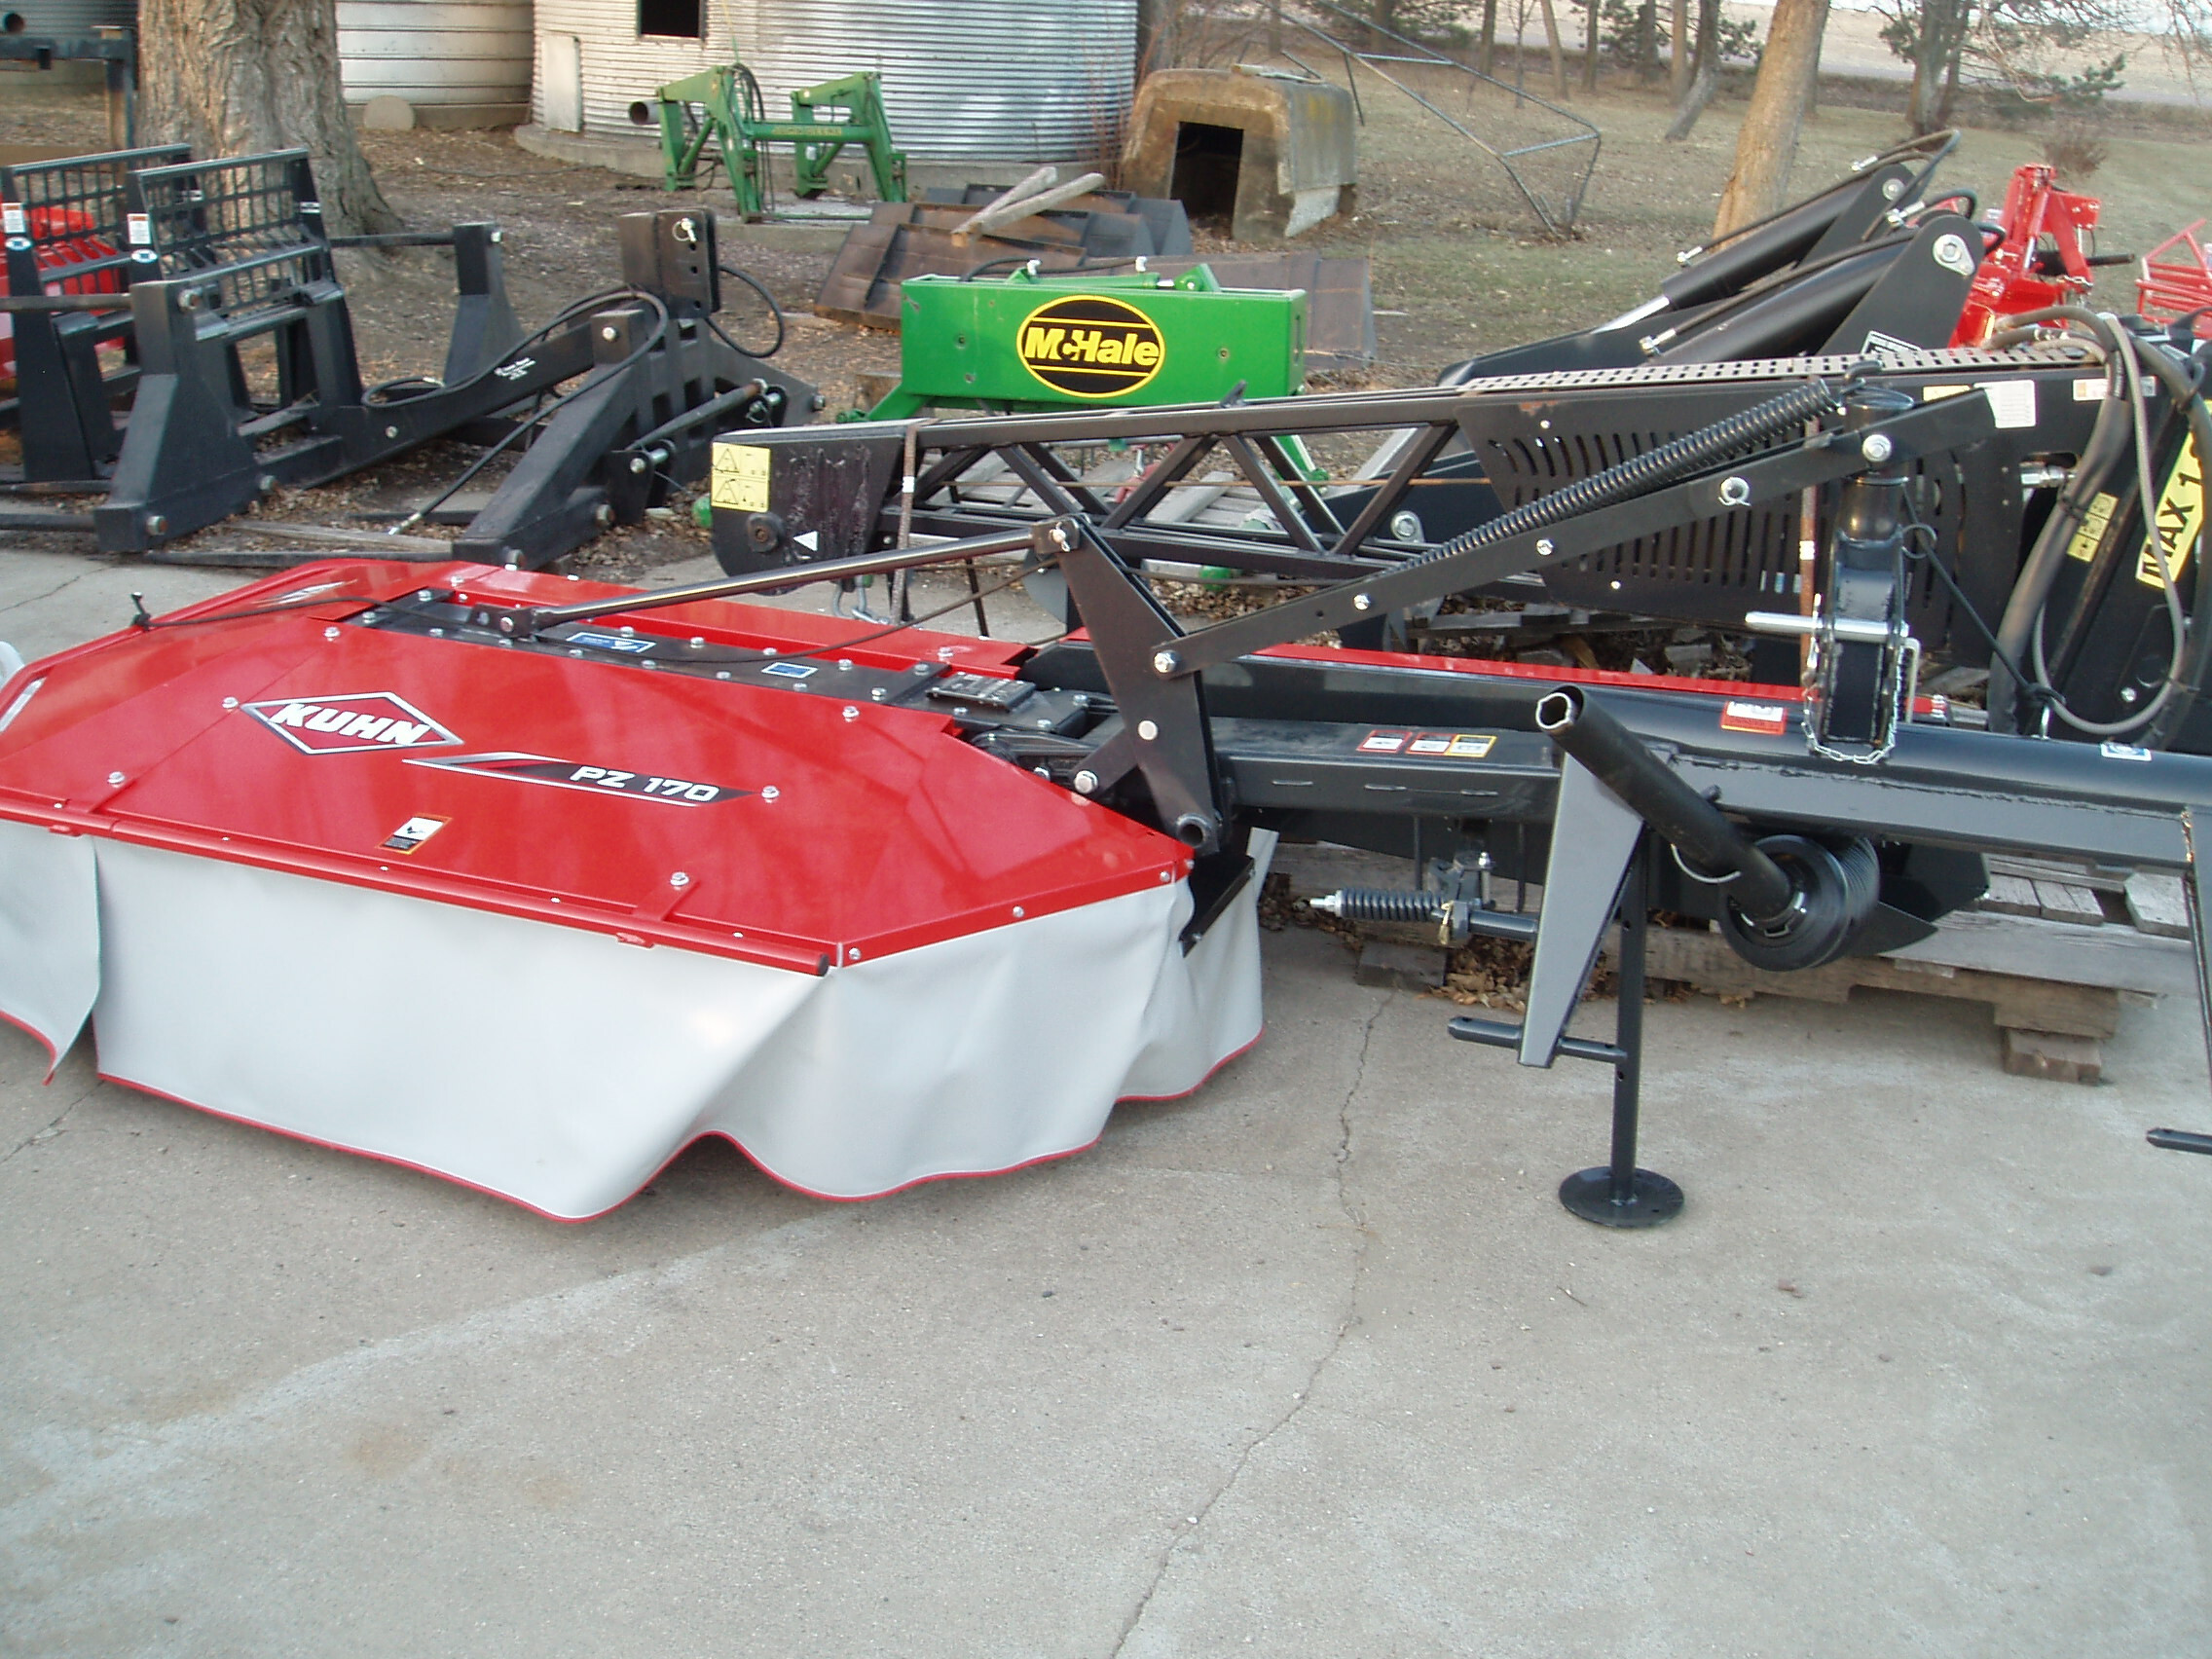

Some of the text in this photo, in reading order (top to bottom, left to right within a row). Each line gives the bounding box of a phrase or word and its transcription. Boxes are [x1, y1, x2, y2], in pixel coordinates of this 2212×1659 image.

[1024, 326, 1160, 366] McHale
[2143, 498, 2194, 576] MAX
[269, 703, 430, 745] KUHN
[570, 765, 720, 802] PZ 170
